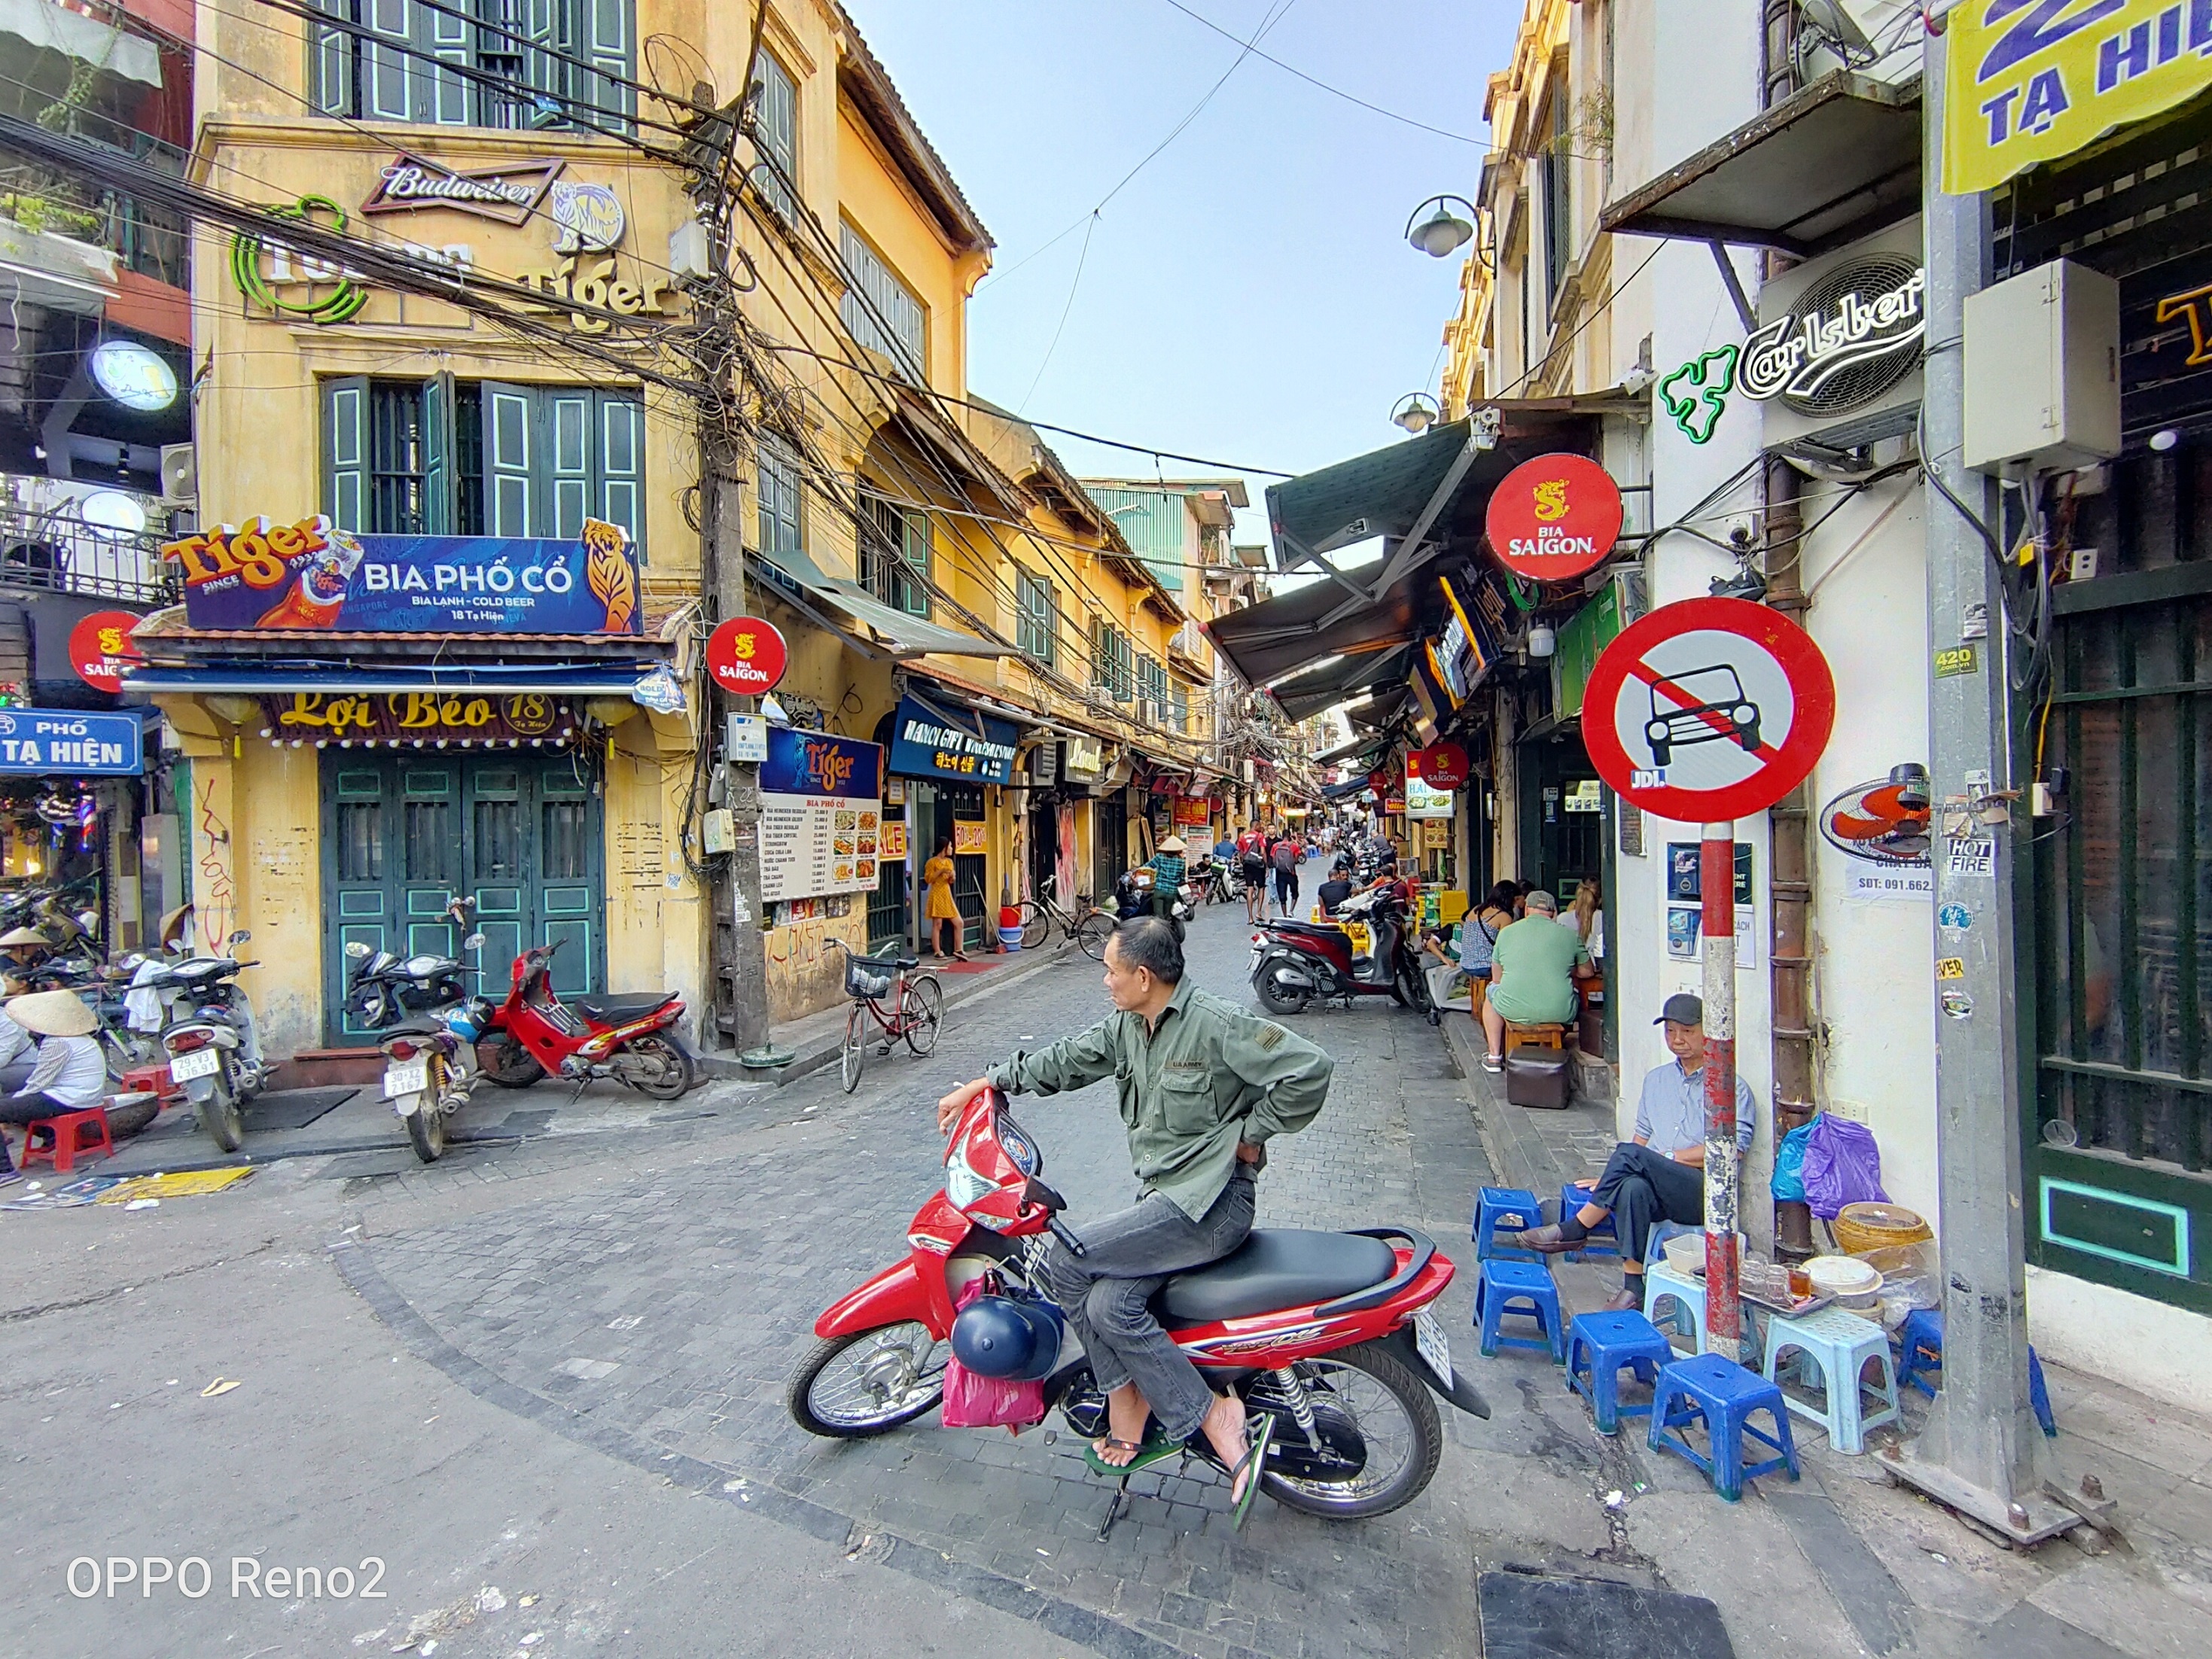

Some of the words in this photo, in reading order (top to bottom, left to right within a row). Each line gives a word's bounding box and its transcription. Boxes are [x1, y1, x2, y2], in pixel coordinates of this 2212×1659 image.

[1981, 67, 2069, 147] TẠ
[379, 166, 538, 203] Budweiser
[515, 257, 672, 333] Tiger
[1735, 268, 1926, 400] Carlsber
[1538, 527, 1563, 537] BIA
[160, 515, 330, 591] Tiger
[1509, 536, 1593, 556] SAIGON
[201, 574, 239, 594] SINCE
[289, 551, 318, 569] 1932
[364, 564, 429, 590] BIA
[433, 556, 515, 592] PHỐ
[521, 555, 573, 593] CỔ
[411, 595, 432, 606] BIA
[432, 596, 465, 609] LẠNH
[473, 596, 503, 607] COLD
[505, 597, 535, 607] BEER
[452, 610, 464, 620] 18
[466, 610, 479, 623] Tạ
[480, 610, 504, 623] Hiện
[736, 661, 751, 669] BIA
[1936, 649, 1971, 666] 420
[719, 665, 767, 682] SAIGON
[279, 693, 378, 736] Lợi
[507, 693, 545, 719] 18
[35, 719, 87, 735] PHỐ
[903, 720, 942, 746] HANOI
[940, 728, 964, 751] GIFT
[2, 739, 41, 766] TẠ
[50, 738, 123, 767] HIỆN
[936, 751, 958, 771] 하노이
[806, 742, 855, 791] Tiger
[1951, 841, 1990, 856] HOT
[1951, 857, 1988, 872] FIRE
[392, 1079, 421, 1094] 2167
